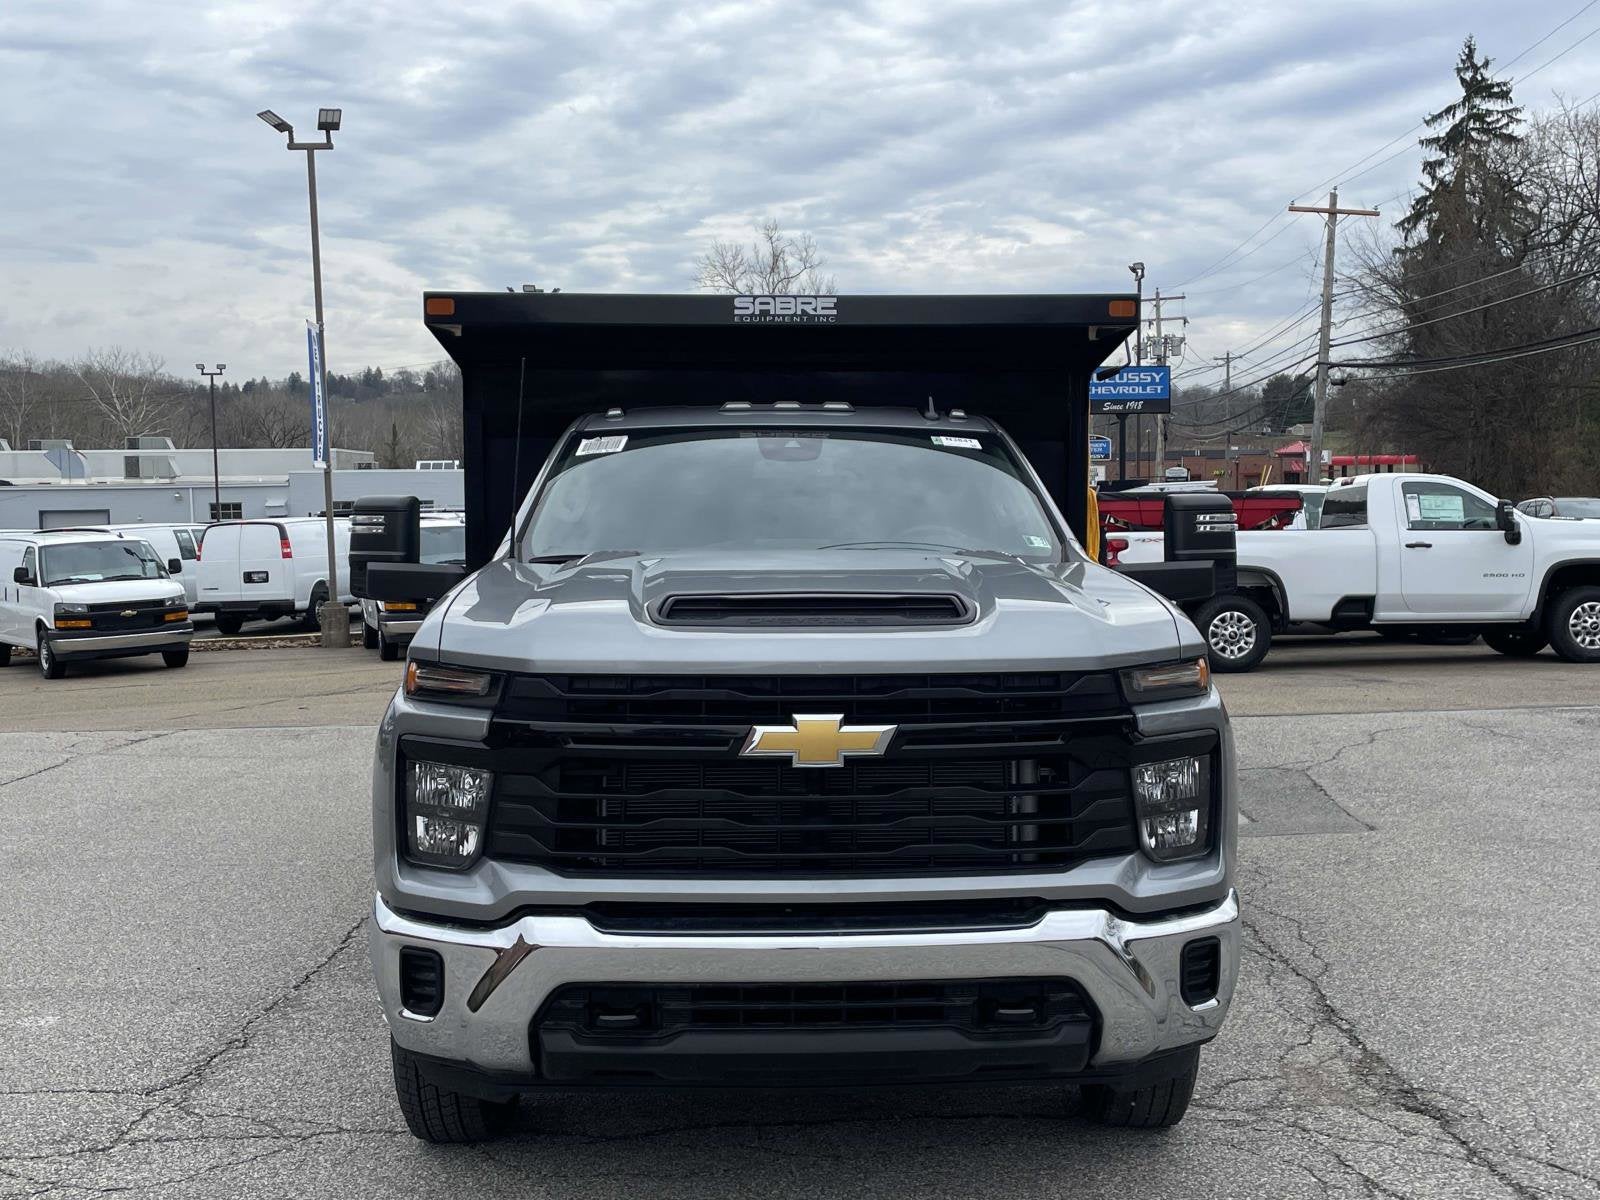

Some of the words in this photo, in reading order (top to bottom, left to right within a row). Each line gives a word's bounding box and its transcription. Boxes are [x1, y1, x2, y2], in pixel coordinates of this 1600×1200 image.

[734, 297, 837, 315] SABRE
[1089, 386, 1163, 395] HEVROLET
[1103, 402, 1123, 411] Since
[1126, 401, 1143, 410] 1918
